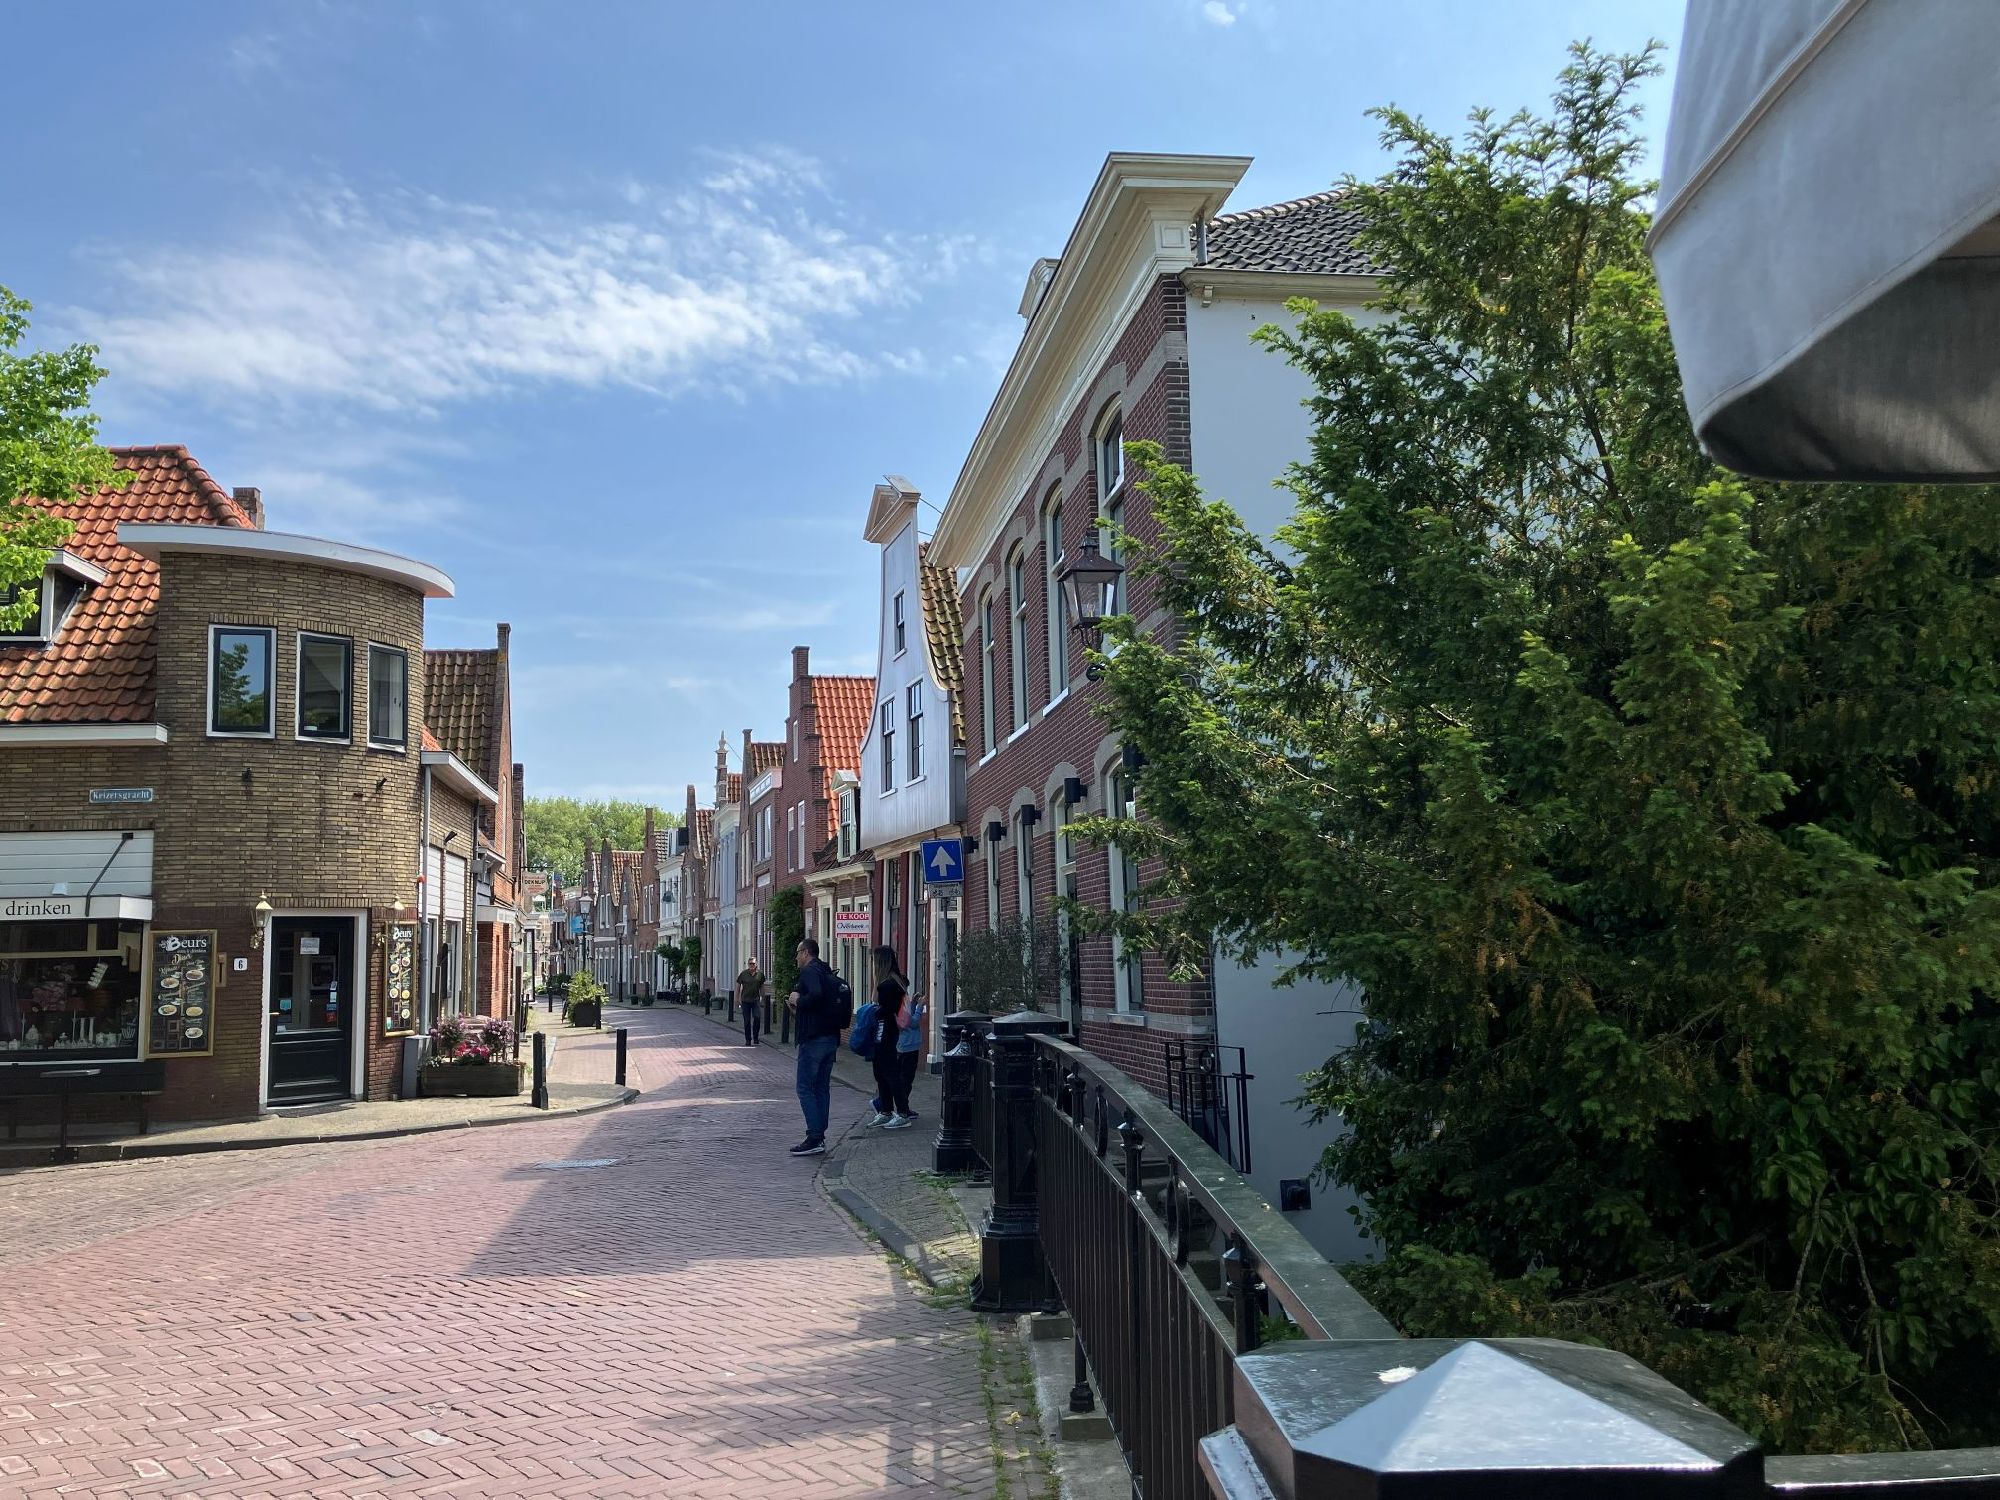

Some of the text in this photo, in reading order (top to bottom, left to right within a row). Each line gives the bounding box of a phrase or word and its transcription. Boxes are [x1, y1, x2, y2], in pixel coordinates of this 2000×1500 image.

[5, 900, 71, 916] drinken
[166, 935, 207, 951] Beurs
[238, 959, 244, 970] 6
